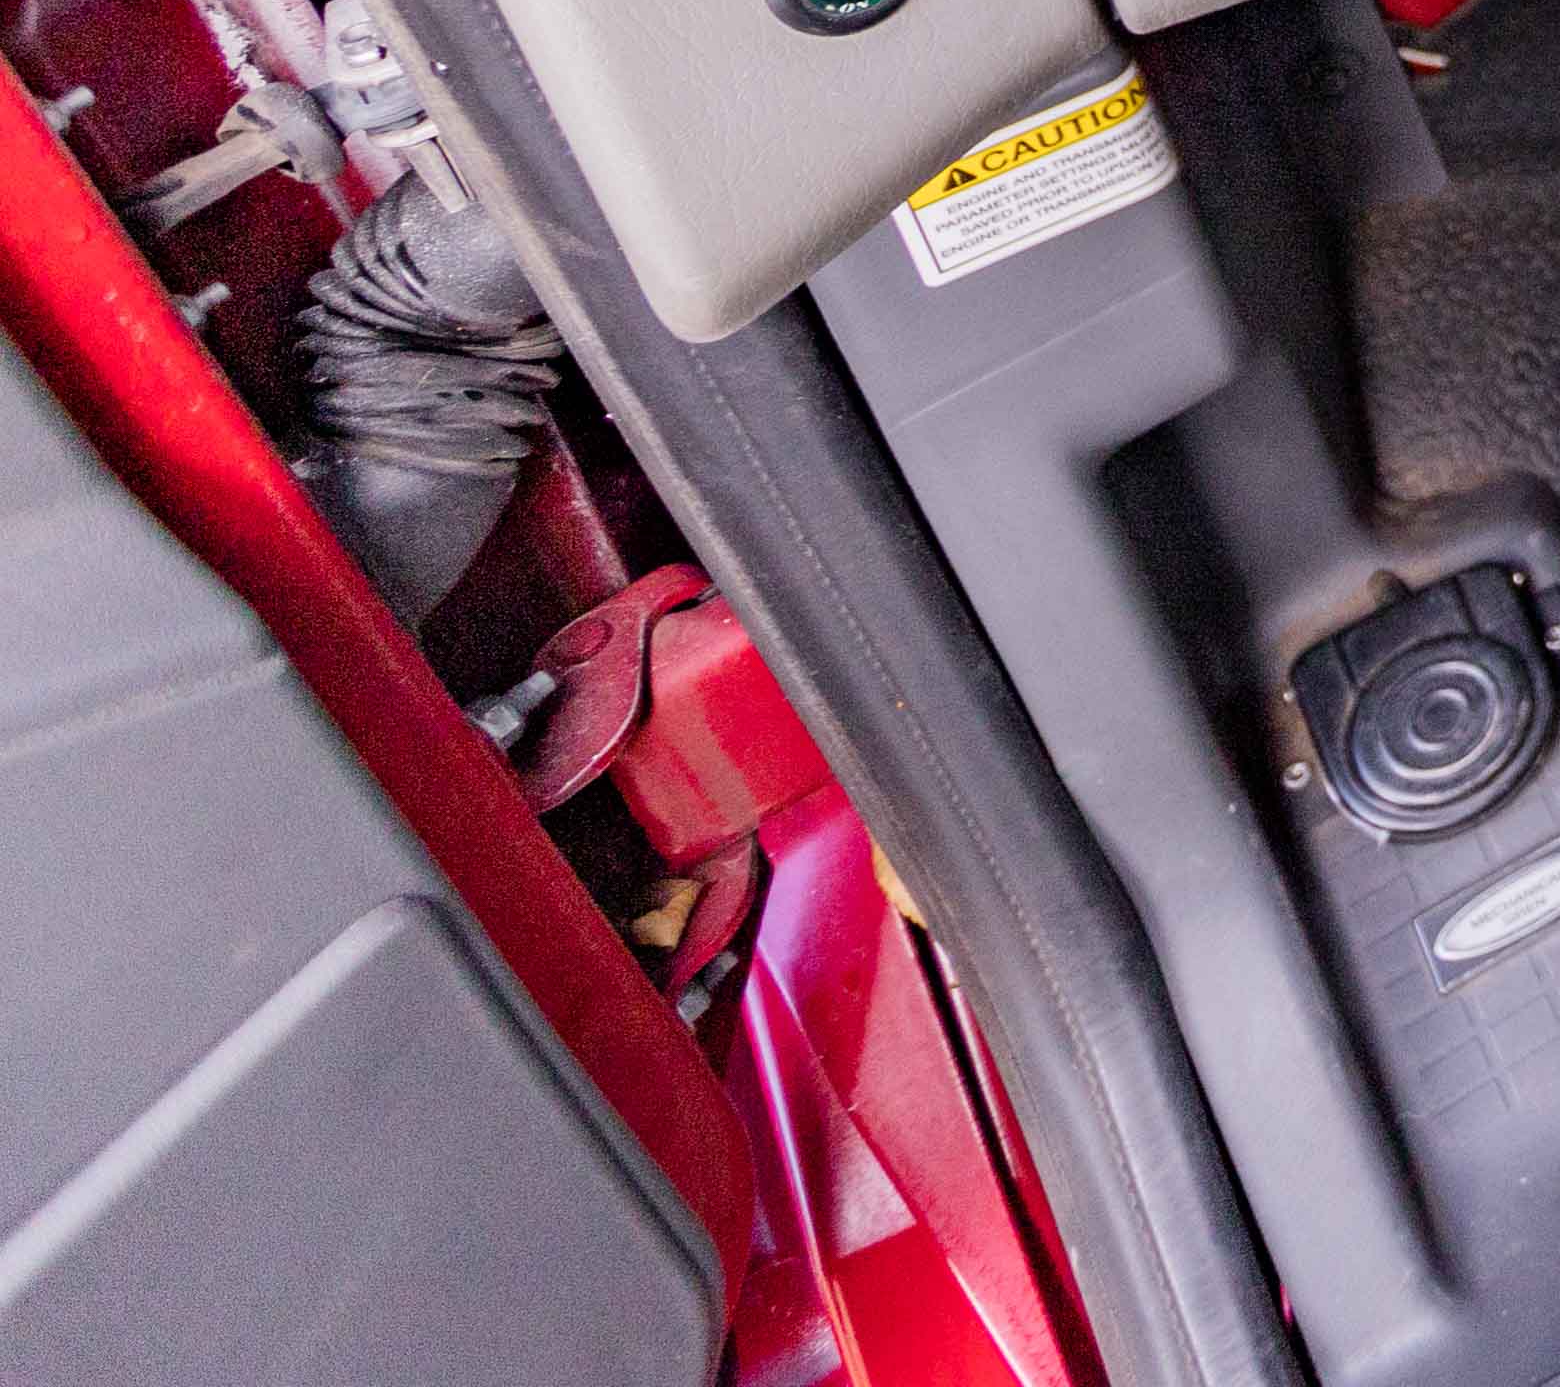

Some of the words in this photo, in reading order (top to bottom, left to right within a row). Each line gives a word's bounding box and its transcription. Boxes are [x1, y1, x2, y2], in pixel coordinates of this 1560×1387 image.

[980, 85, 1147, 172] CAUTION
[935, 186, 1034, 233] PARAMETER
[1039, 151, 1116, 188] SETTINGS
[947, 183, 1007, 215] ENGINE
[1014, 166, 1046, 186] AND
[960, 209, 1014, 236] SAVED
[1017, 185, 1068, 212] PRIOR
[941, 227, 1002, 259] ENGINE
[1006, 214, 1031, 230] OR
